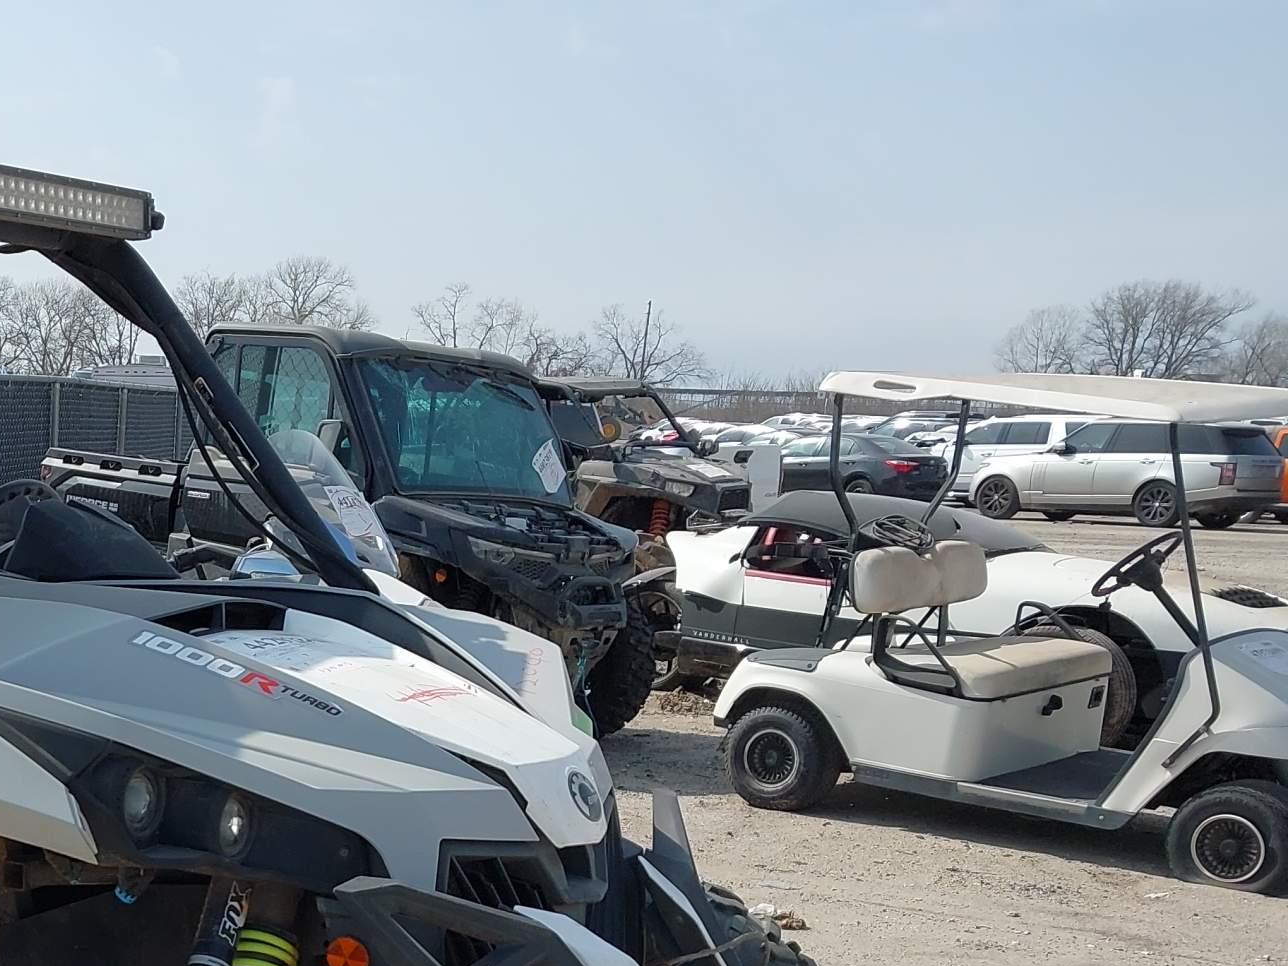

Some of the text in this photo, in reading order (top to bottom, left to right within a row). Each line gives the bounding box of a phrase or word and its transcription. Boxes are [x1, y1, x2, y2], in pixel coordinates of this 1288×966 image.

[133, 631, 280, 695] 1000R
[281, 685, 343, 716] TURBO
[218, 881, 252, 947] FOX
